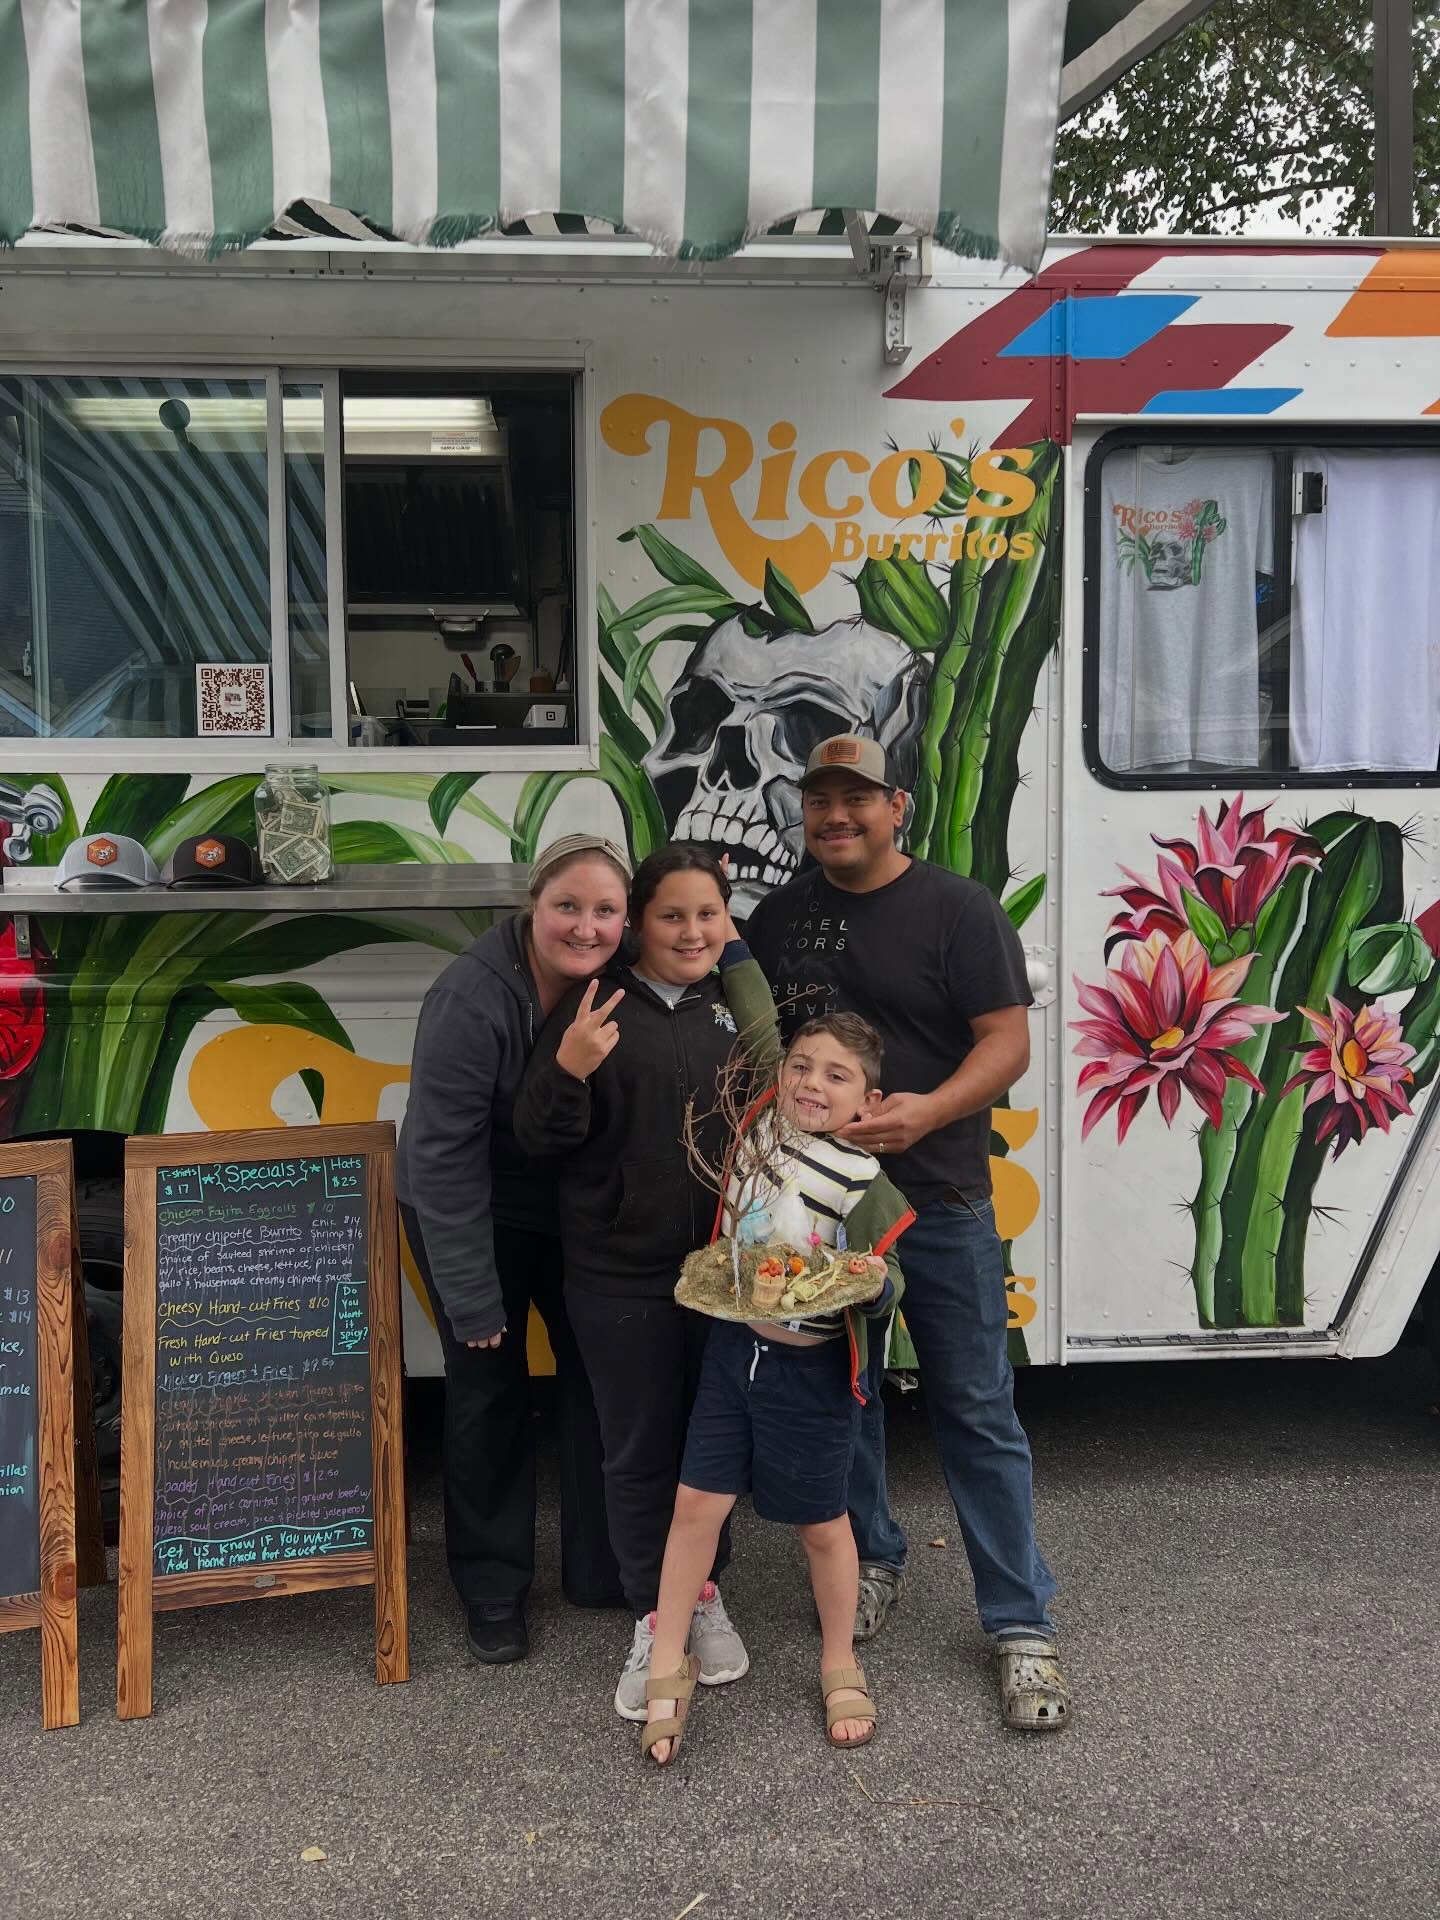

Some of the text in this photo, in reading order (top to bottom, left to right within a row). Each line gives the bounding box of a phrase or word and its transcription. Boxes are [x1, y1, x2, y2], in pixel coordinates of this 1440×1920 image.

[600, 393, 1036, 595] Rico's
[833, 521, 1035, 562] Burritos
[226, 1162, 296, 1185] Specials
[331, 1157, 362, 1171] Hats
[332, 1175, 358, 1189] $25
[342, 1285, 358, 1296] Do
[158, 1300, 202, 1318] Cheesy
[308, 1296, 330, 1309] $10
[158, 1335, 188, 1351] Fresh
[290, 1325, 330, 1342] topped
[164, 1478, 199, 1494] oaded
[155, 1508, 187, 1522] hoice
